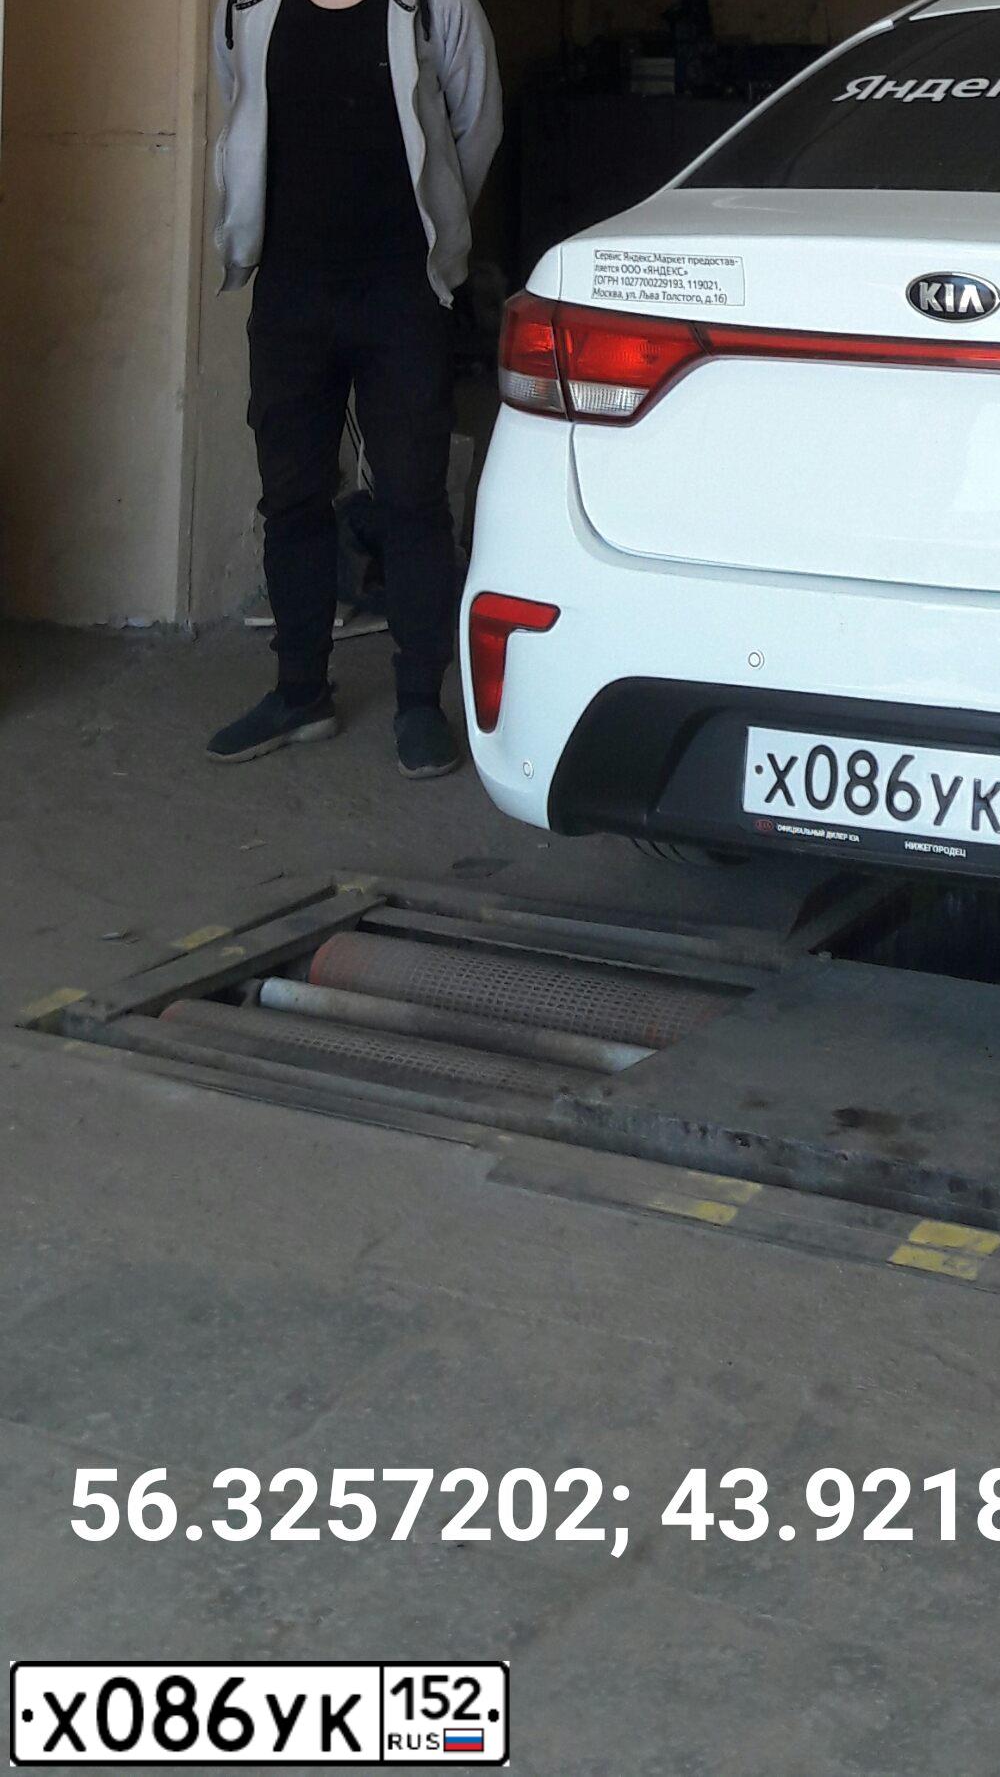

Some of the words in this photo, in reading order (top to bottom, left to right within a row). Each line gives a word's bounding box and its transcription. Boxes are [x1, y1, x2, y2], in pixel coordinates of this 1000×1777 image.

[595, 250, 621, 261] Сервис
[623, 253, 685, 265] Яндекс.Маркет
[621, 264, 641, 275] ООО
[643, 265, 688, 277] «ЯНДЕКС»
[594, 276, 618, 286] (ОГРН
[593, 288, 623, 299] Москва,
[639, 291, 659, 301] Льва
[918, 282, 986, 314] KIA
[904, 840, 967, 858] НИЖЕГОРОДЕЦ
